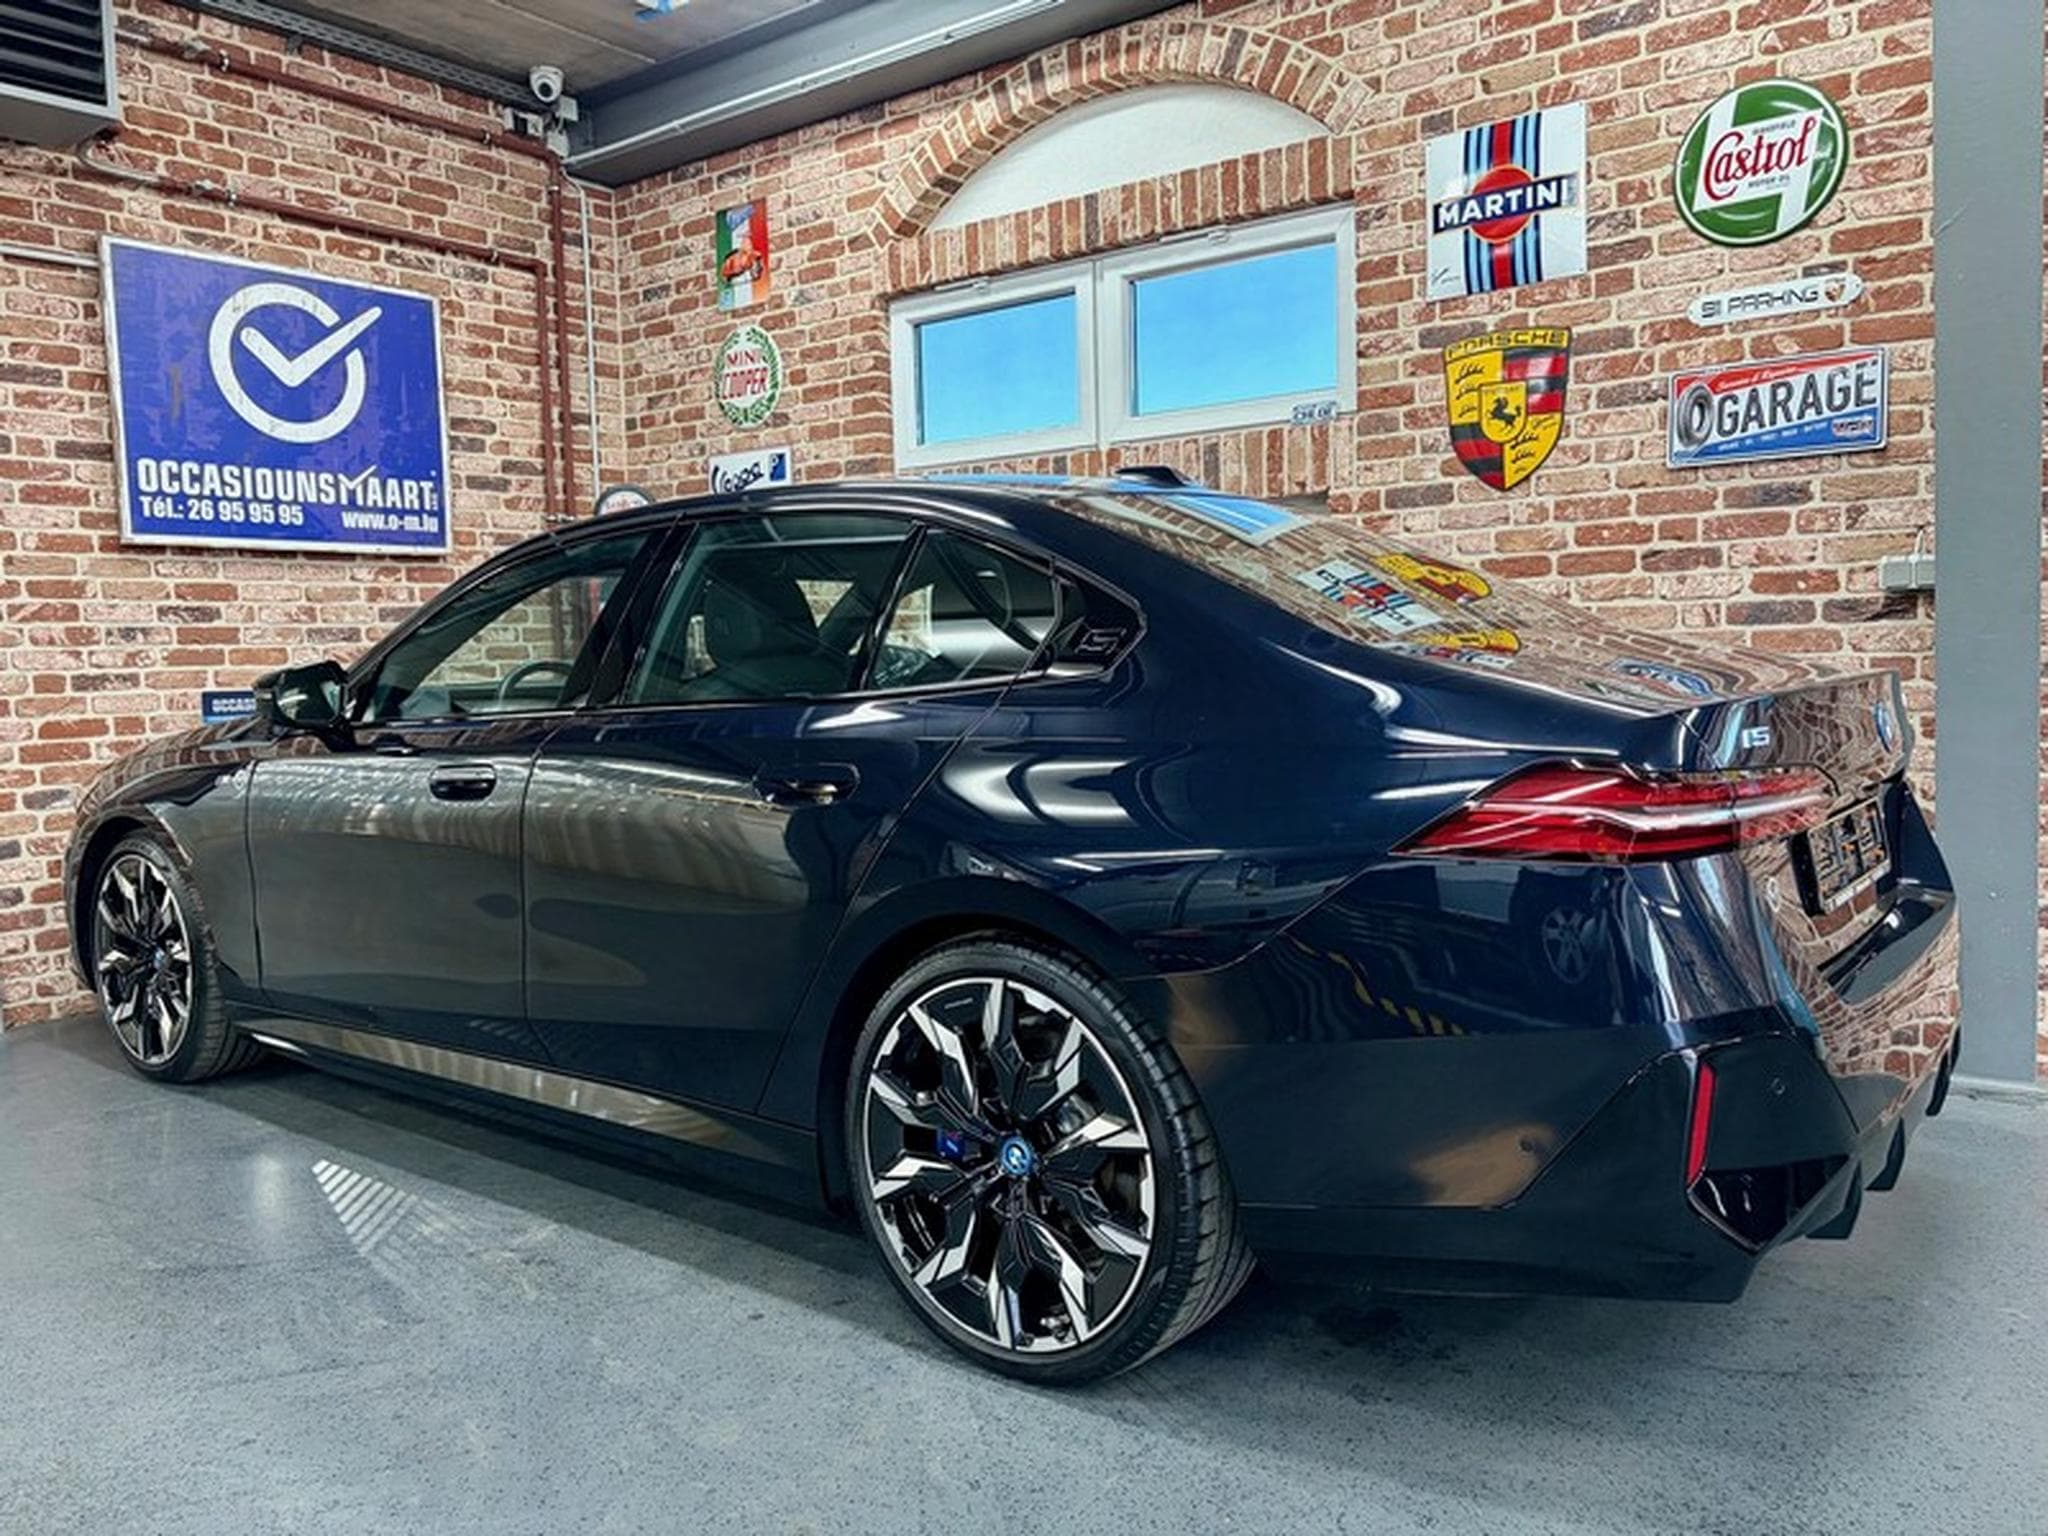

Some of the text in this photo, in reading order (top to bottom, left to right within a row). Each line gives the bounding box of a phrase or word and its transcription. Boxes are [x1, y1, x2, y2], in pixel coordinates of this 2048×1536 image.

[1704, 116, 1816, 201] Castrol
[1437, 178, 1569, 229] MARTINI
[1729, 286, 1818, 312] PARKING
[1448, 331, 1564, 358] PORSCHE
[723, 366, 769, 400] COOPER
[1716, 361, 1878, 438] GARAGE
[187, 499, 214, 521] 26
[218, 500, 245, 523] 95
[249, 502, 275, 525] 95
[278, 504, 304, 526] 95
[341, 510, 439, 534] www.o-m.lu
